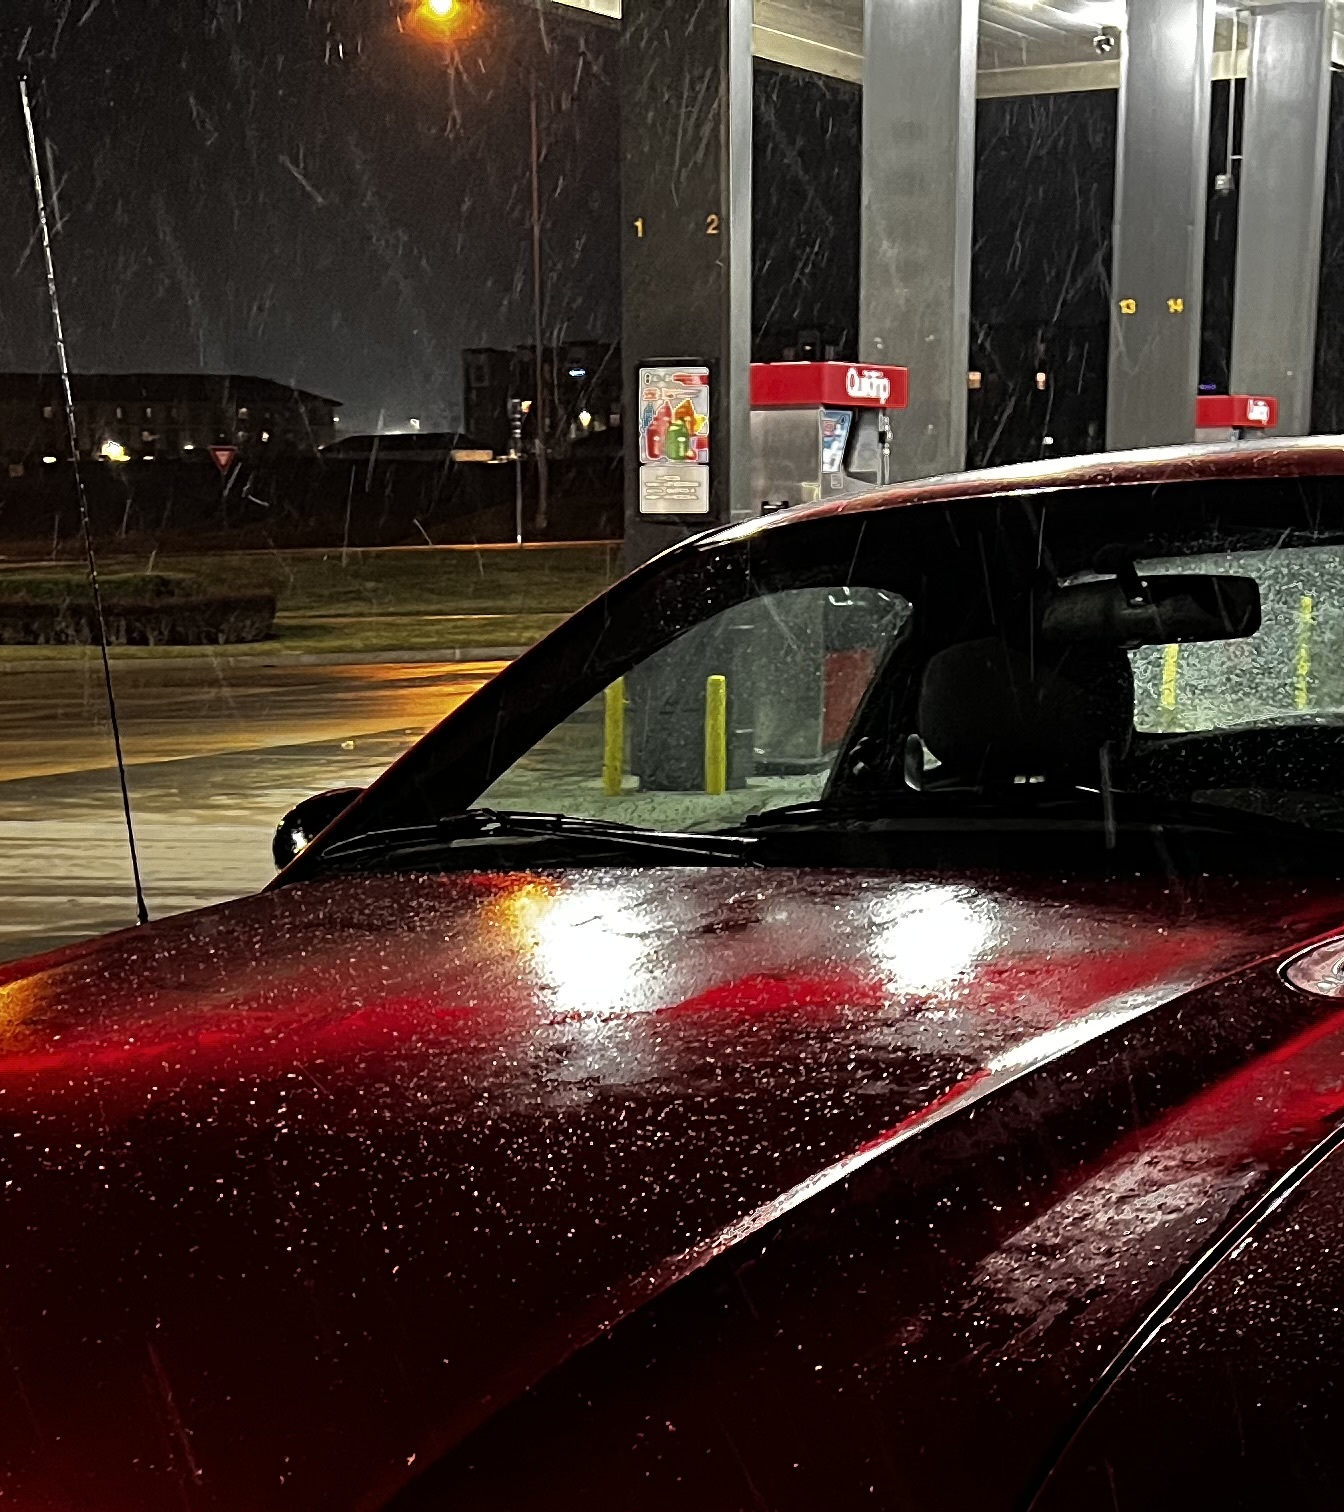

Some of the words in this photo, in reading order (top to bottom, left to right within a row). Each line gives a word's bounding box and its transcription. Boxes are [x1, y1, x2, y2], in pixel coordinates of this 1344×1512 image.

[633, 217, 643, 238] 1
[705, 214, 719, 234] 2
[1167, 298, 1184, 314] 14
